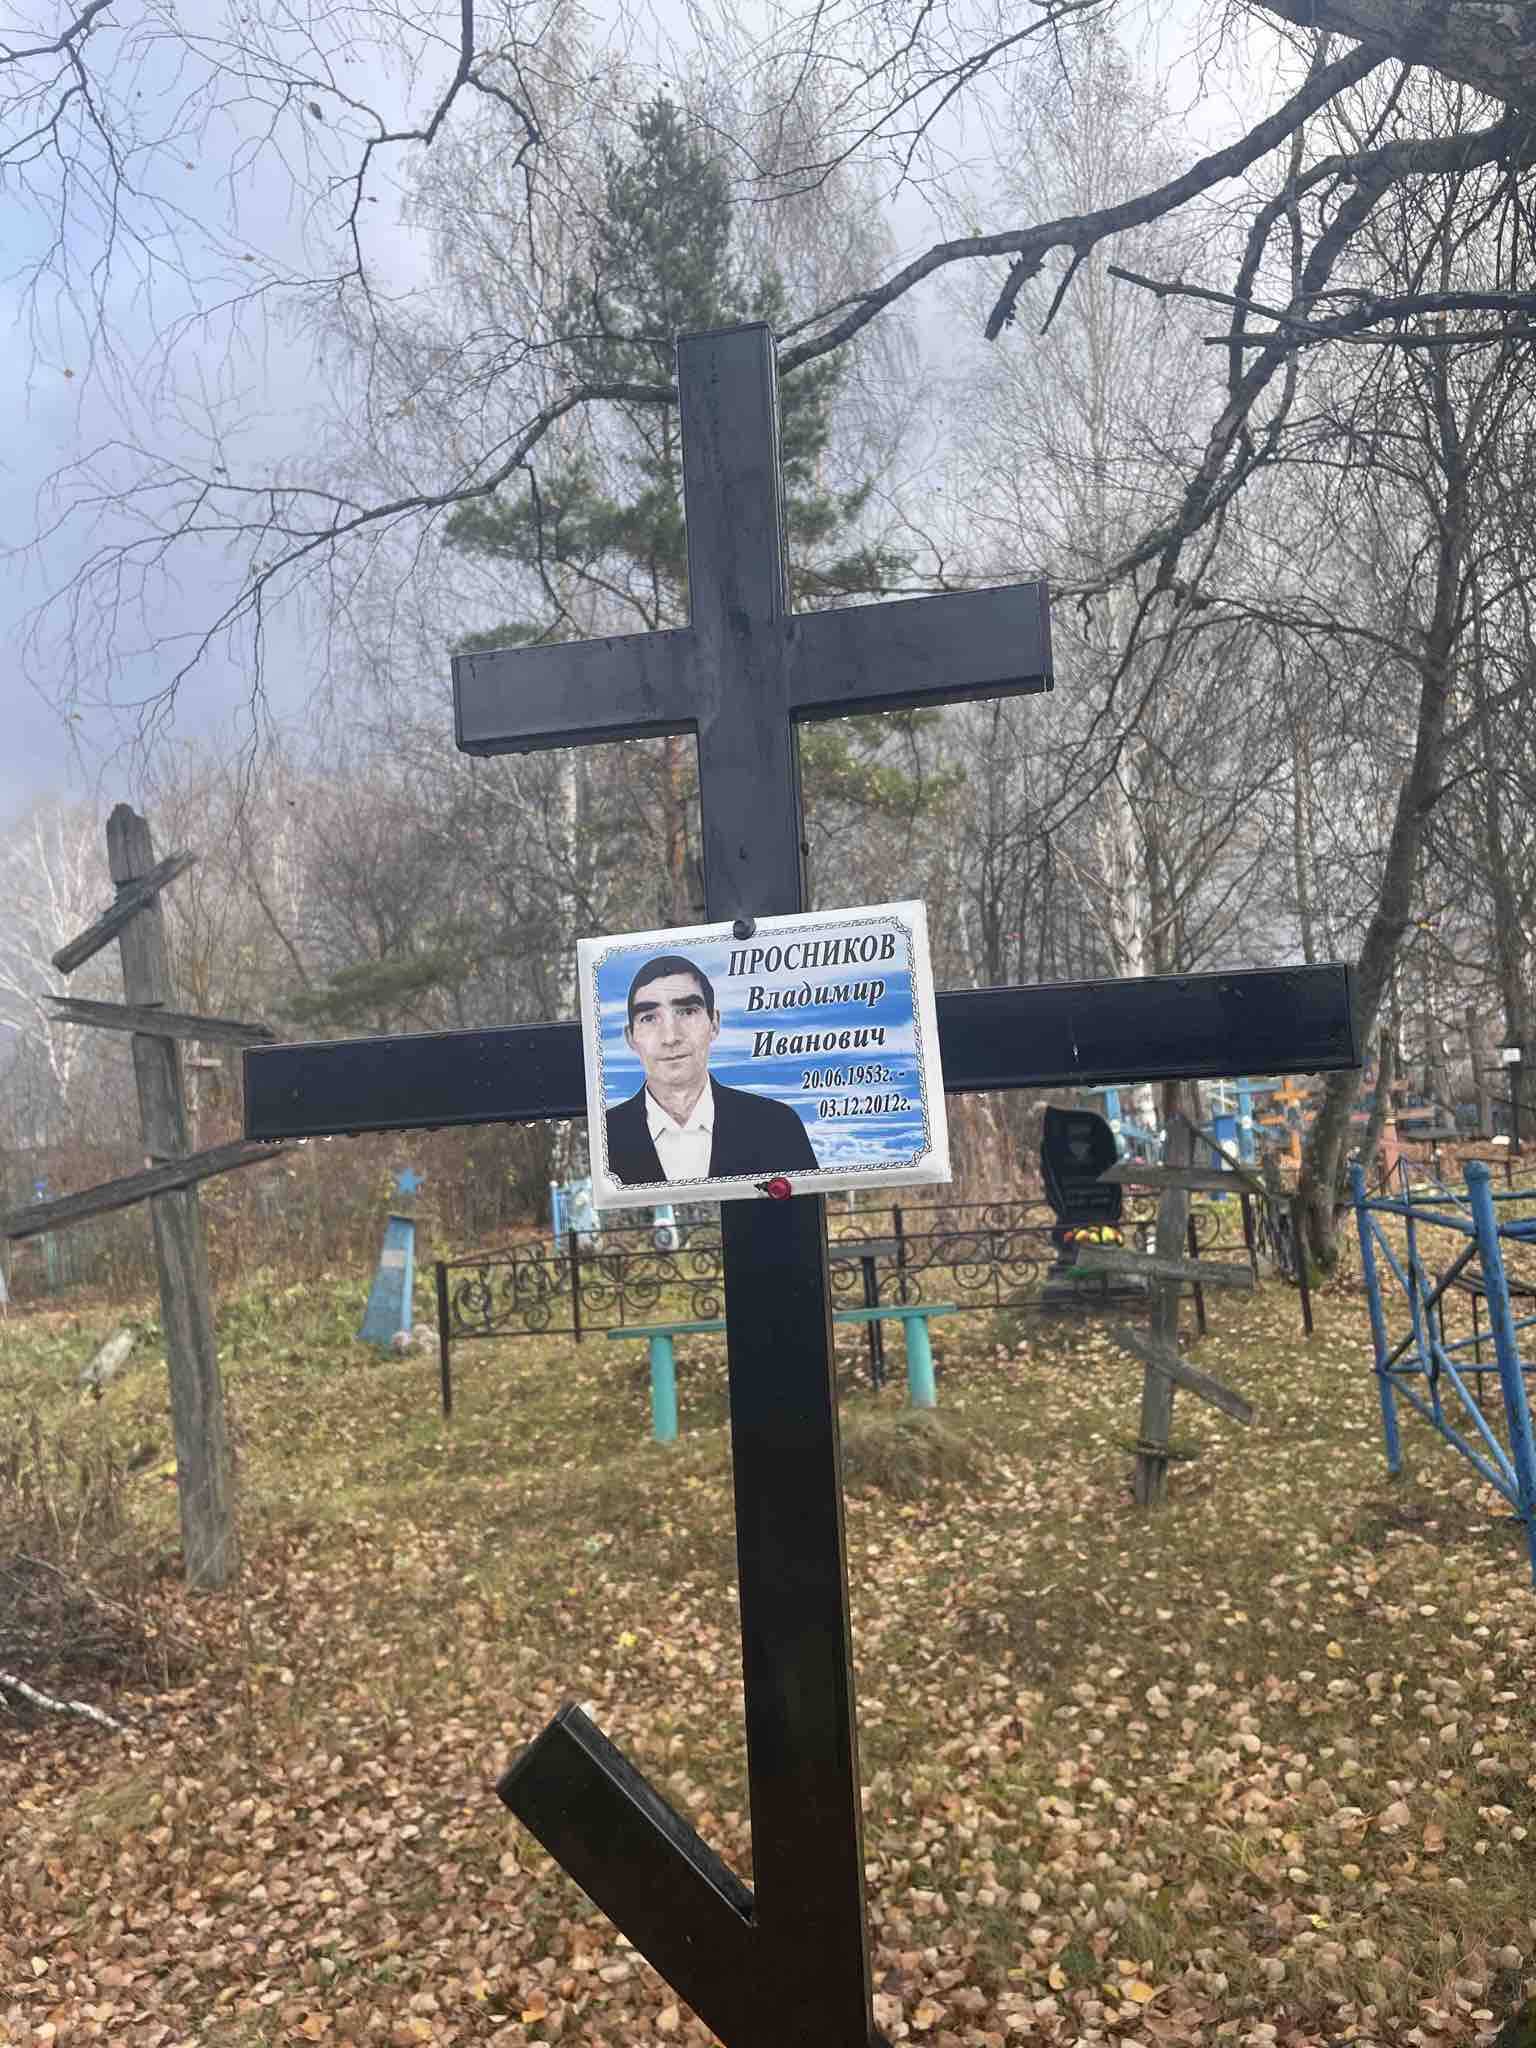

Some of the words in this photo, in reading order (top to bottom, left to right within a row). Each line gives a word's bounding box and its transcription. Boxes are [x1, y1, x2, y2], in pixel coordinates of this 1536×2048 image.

[727, 933, 896, 977] ПРОСНИКОВ
[747, 978, 885, 1012] Владимир
[751, 1026, 885, 1057] Иванович
[802, 1065, 893, 1089] 20.06.1953г.
[819, 1094, 911, 1118] 03.12.2012г.
